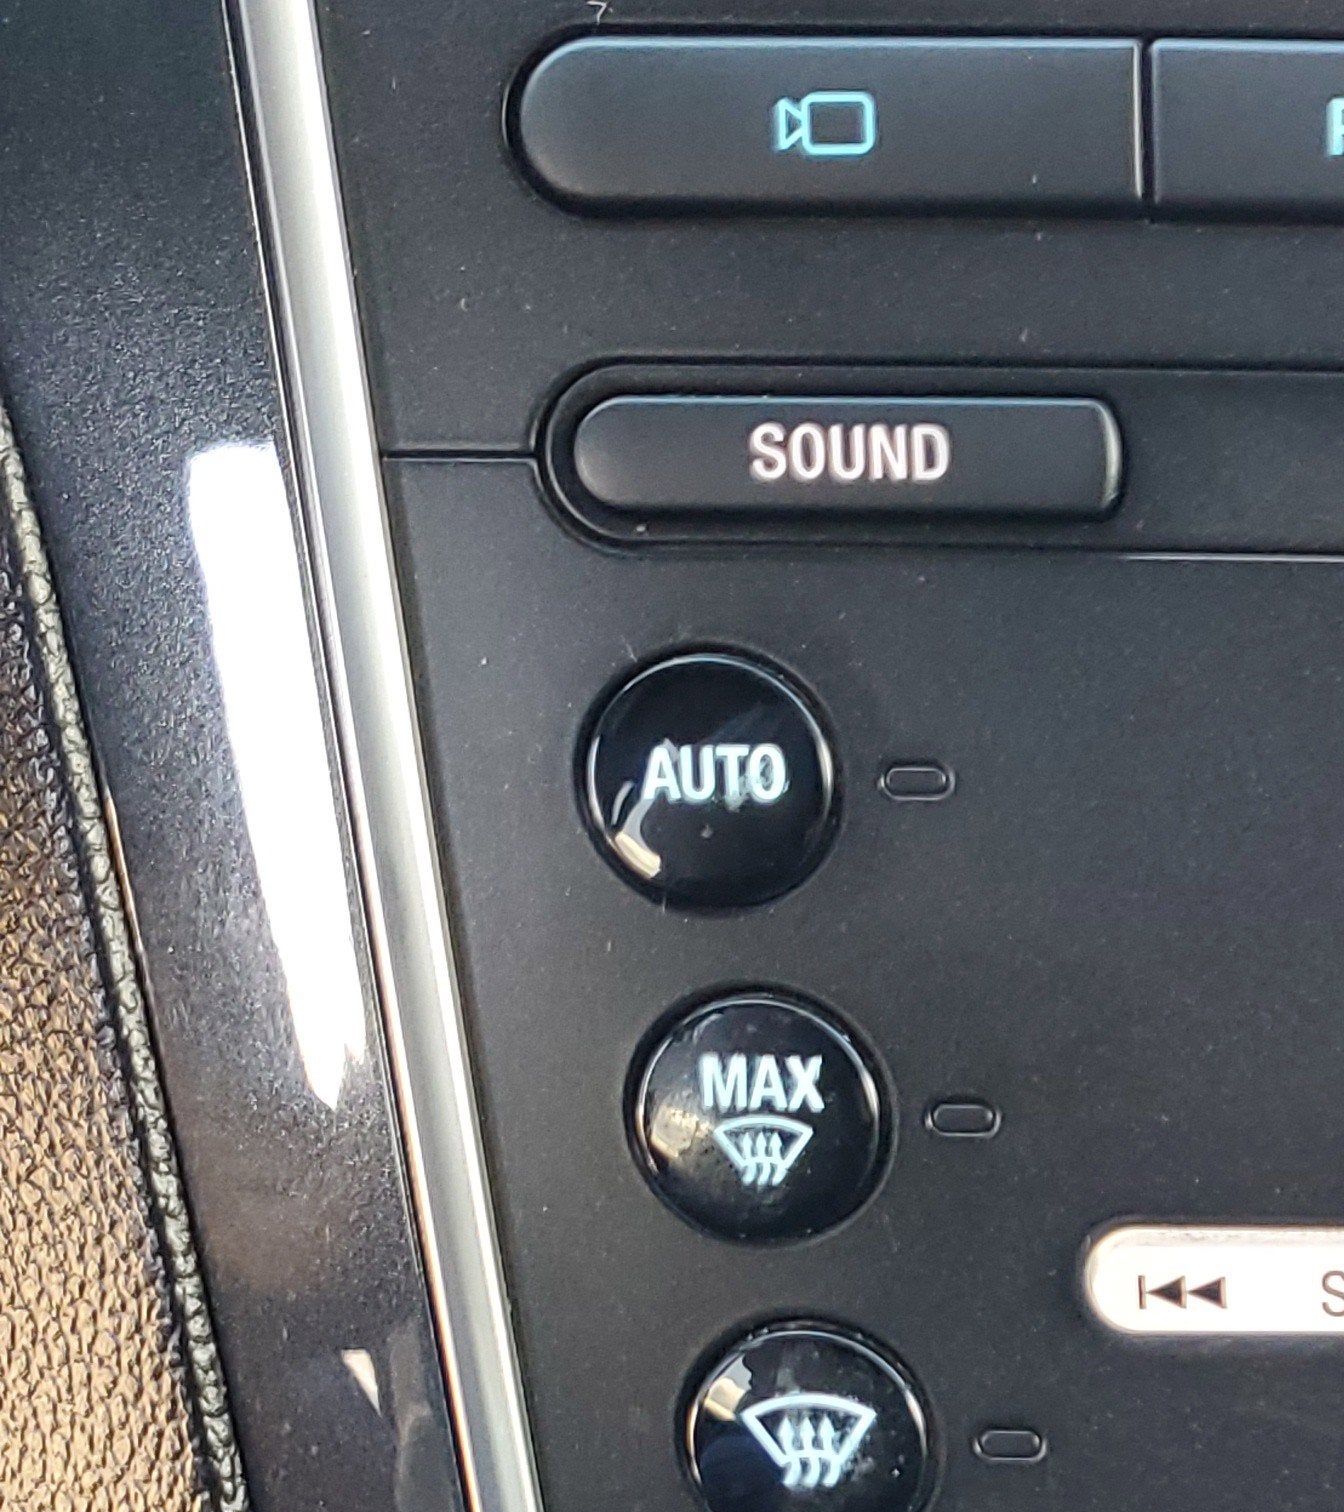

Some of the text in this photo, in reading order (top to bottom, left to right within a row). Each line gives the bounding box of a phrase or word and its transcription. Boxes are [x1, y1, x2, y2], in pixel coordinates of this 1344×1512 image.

[748, 422, 950, 482] SOUND
[642, 743, 787, 803] AUTO
[699, 1052, 825, 1113] MAX
